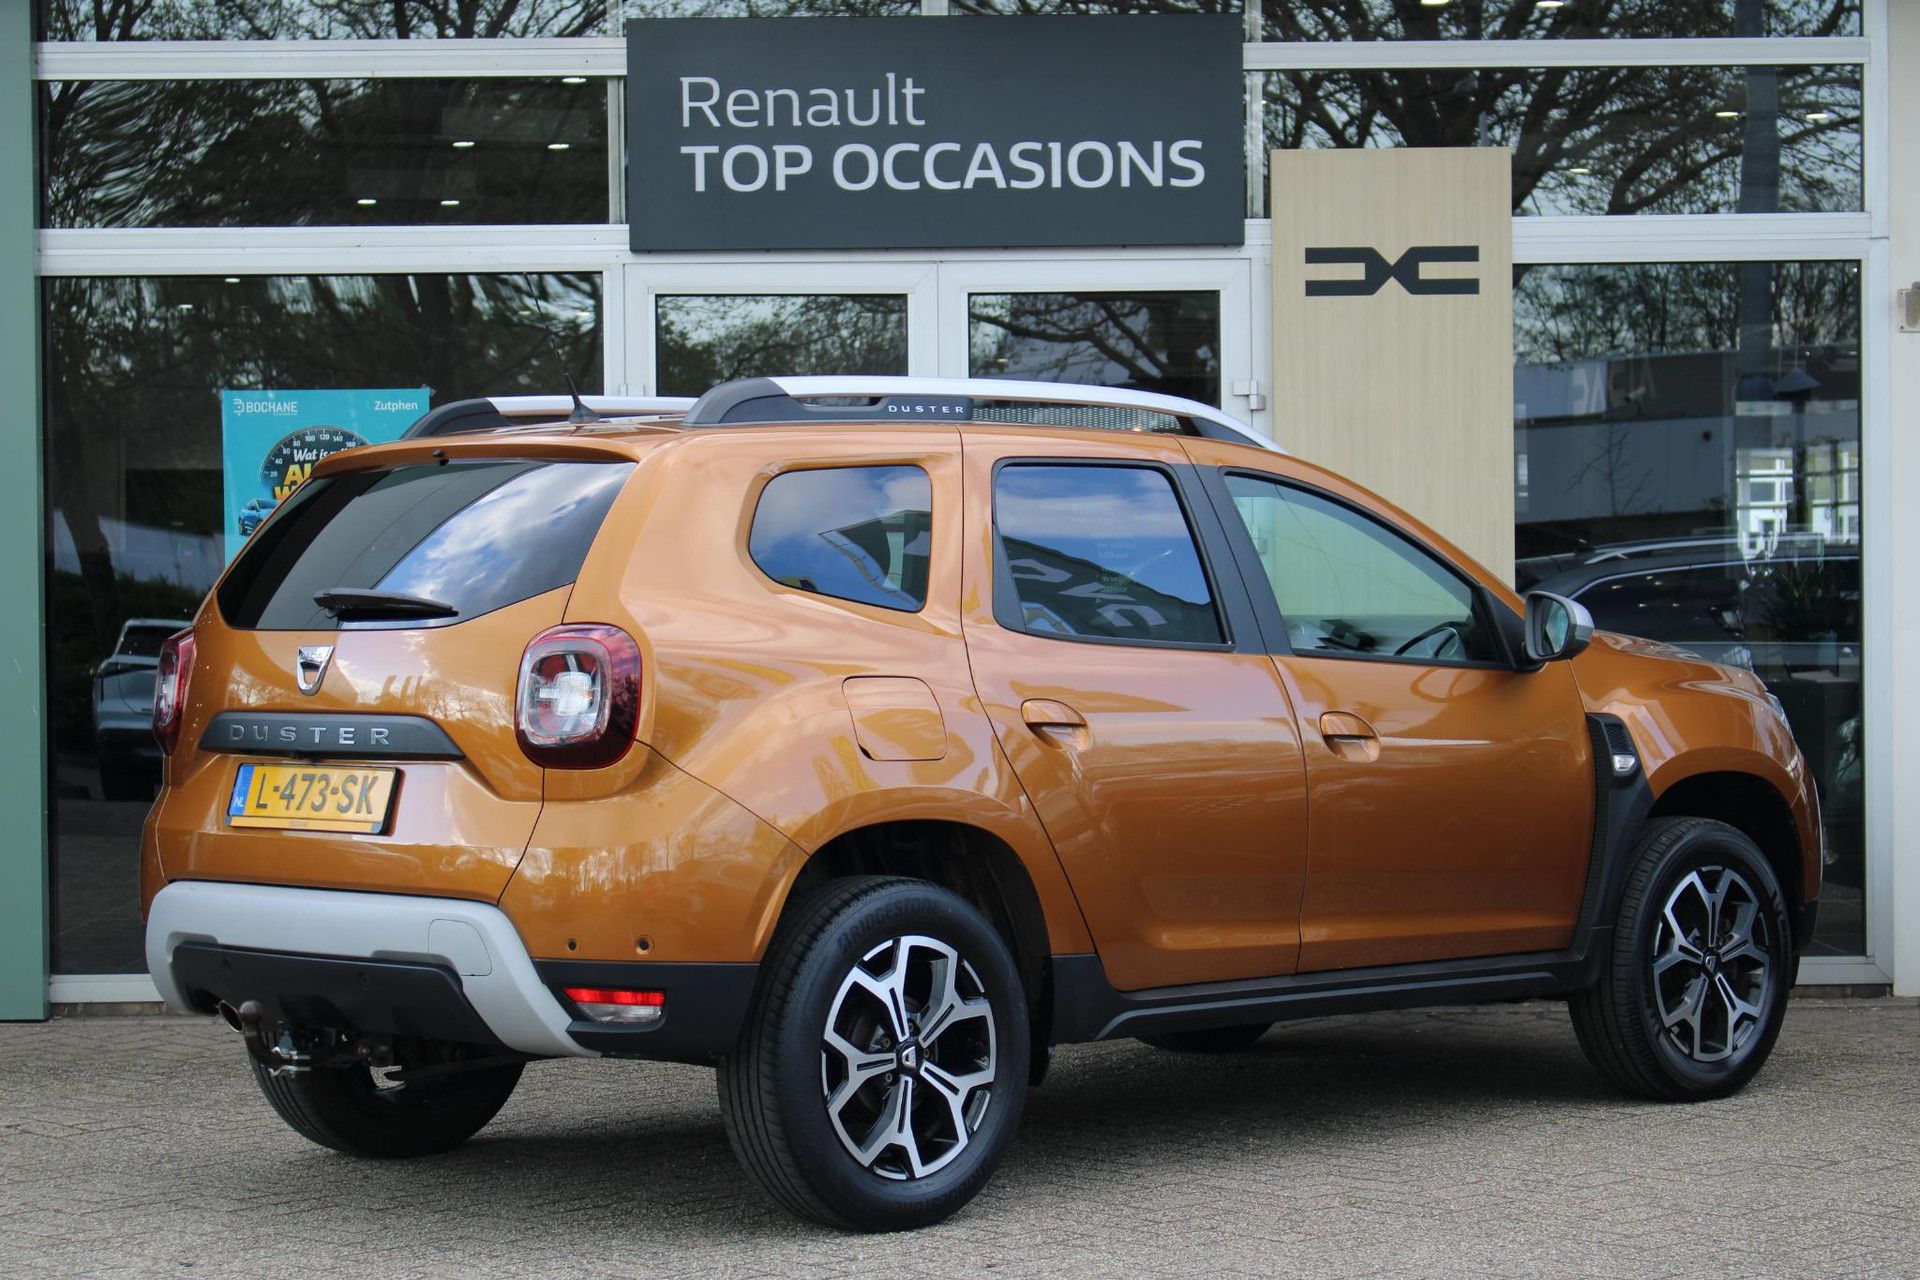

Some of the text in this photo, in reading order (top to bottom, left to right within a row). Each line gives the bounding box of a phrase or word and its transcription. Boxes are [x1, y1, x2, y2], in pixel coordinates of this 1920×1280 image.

[679, 72, 926, 128] Renault
[679, 139, 1206, 193] TOP OCCASIONS
[246, 400, 299, 413] BOCHANE
[374, 400, 418, 413] Zutphen
[887, 404, 965, 414] DUSTER
[293, 448, 318, 462] Wat
[228, 723, 390, 746] DUSTER
[255, 773, 380, 815] L-473-SK
[233, 795, 245, 808] NL
